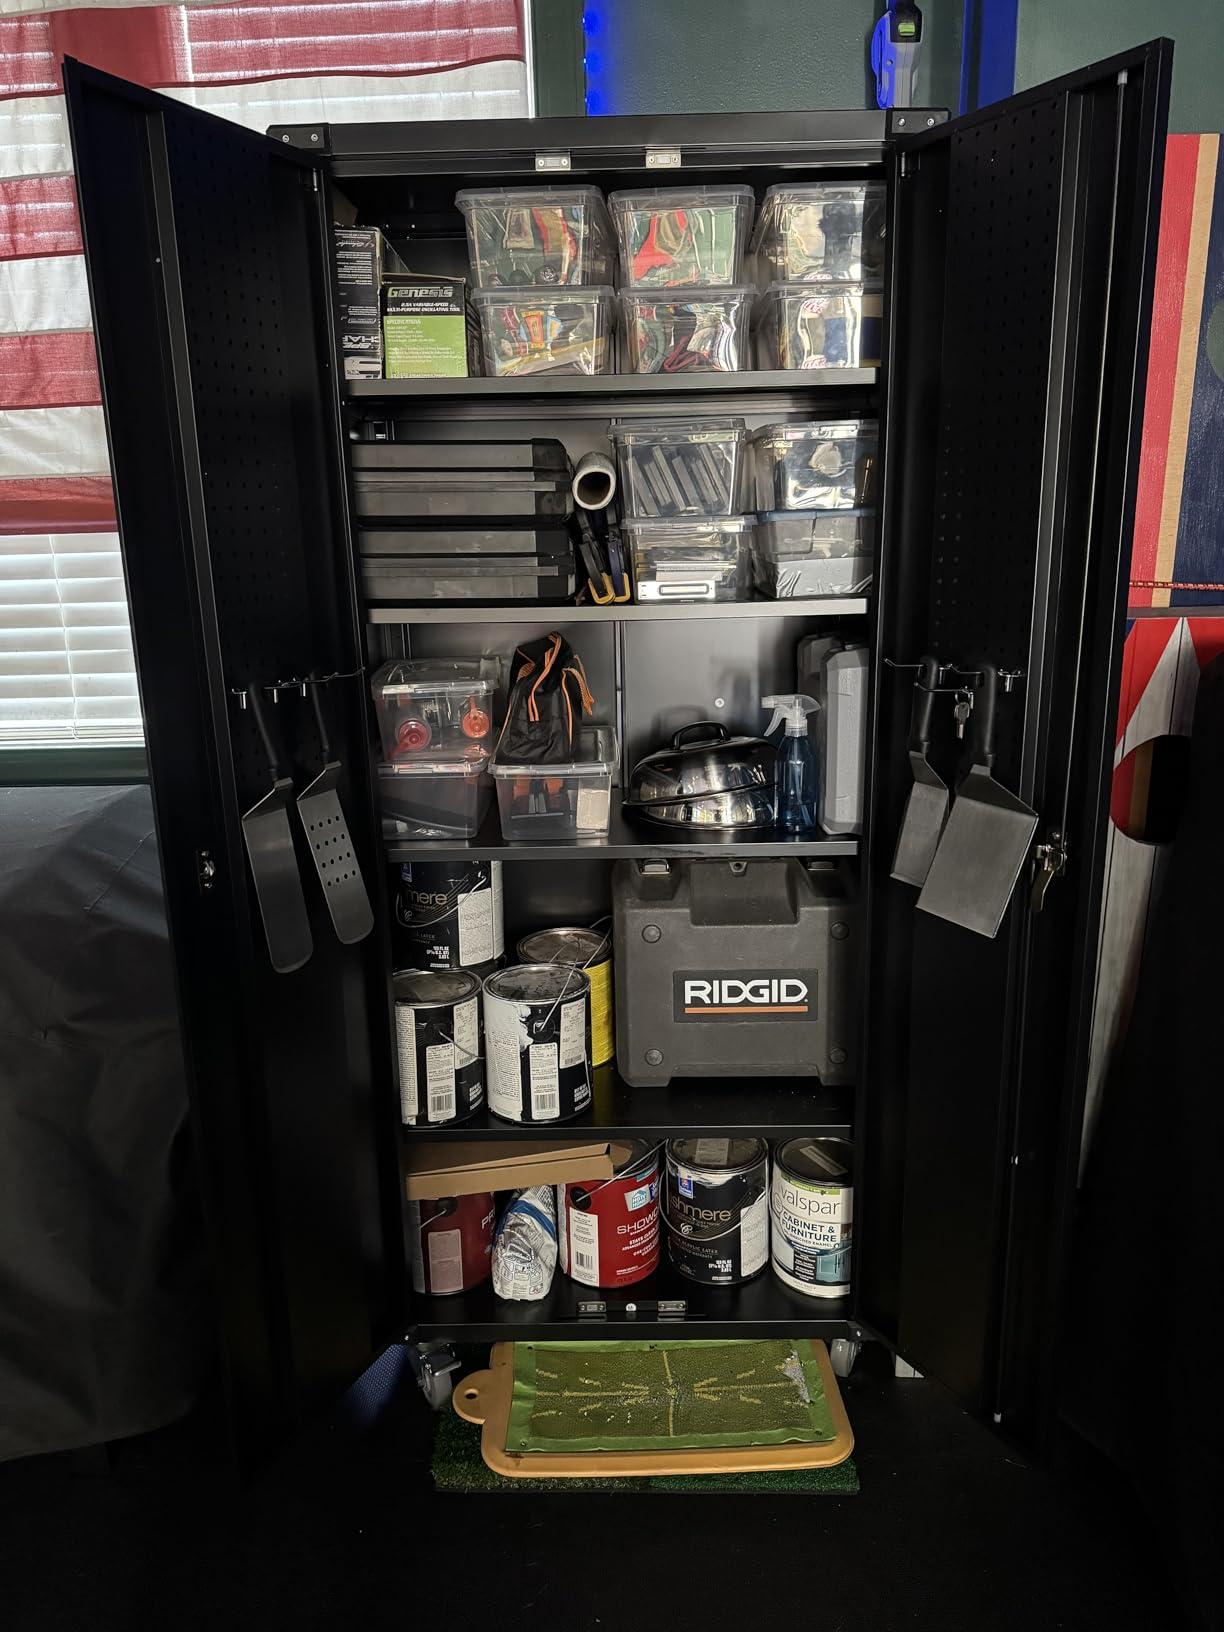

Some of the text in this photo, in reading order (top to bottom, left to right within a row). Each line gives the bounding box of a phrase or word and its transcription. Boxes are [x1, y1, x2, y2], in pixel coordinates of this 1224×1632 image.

[387, 286, 454, 298] Genesis
[684, 978, 807, 1004] RIDGID
[780, 1185, 841, 1216] valspar
[782, 1219, 837, 1243] FURNITURE
[783, 1211, 835, 1234] CABINET &
